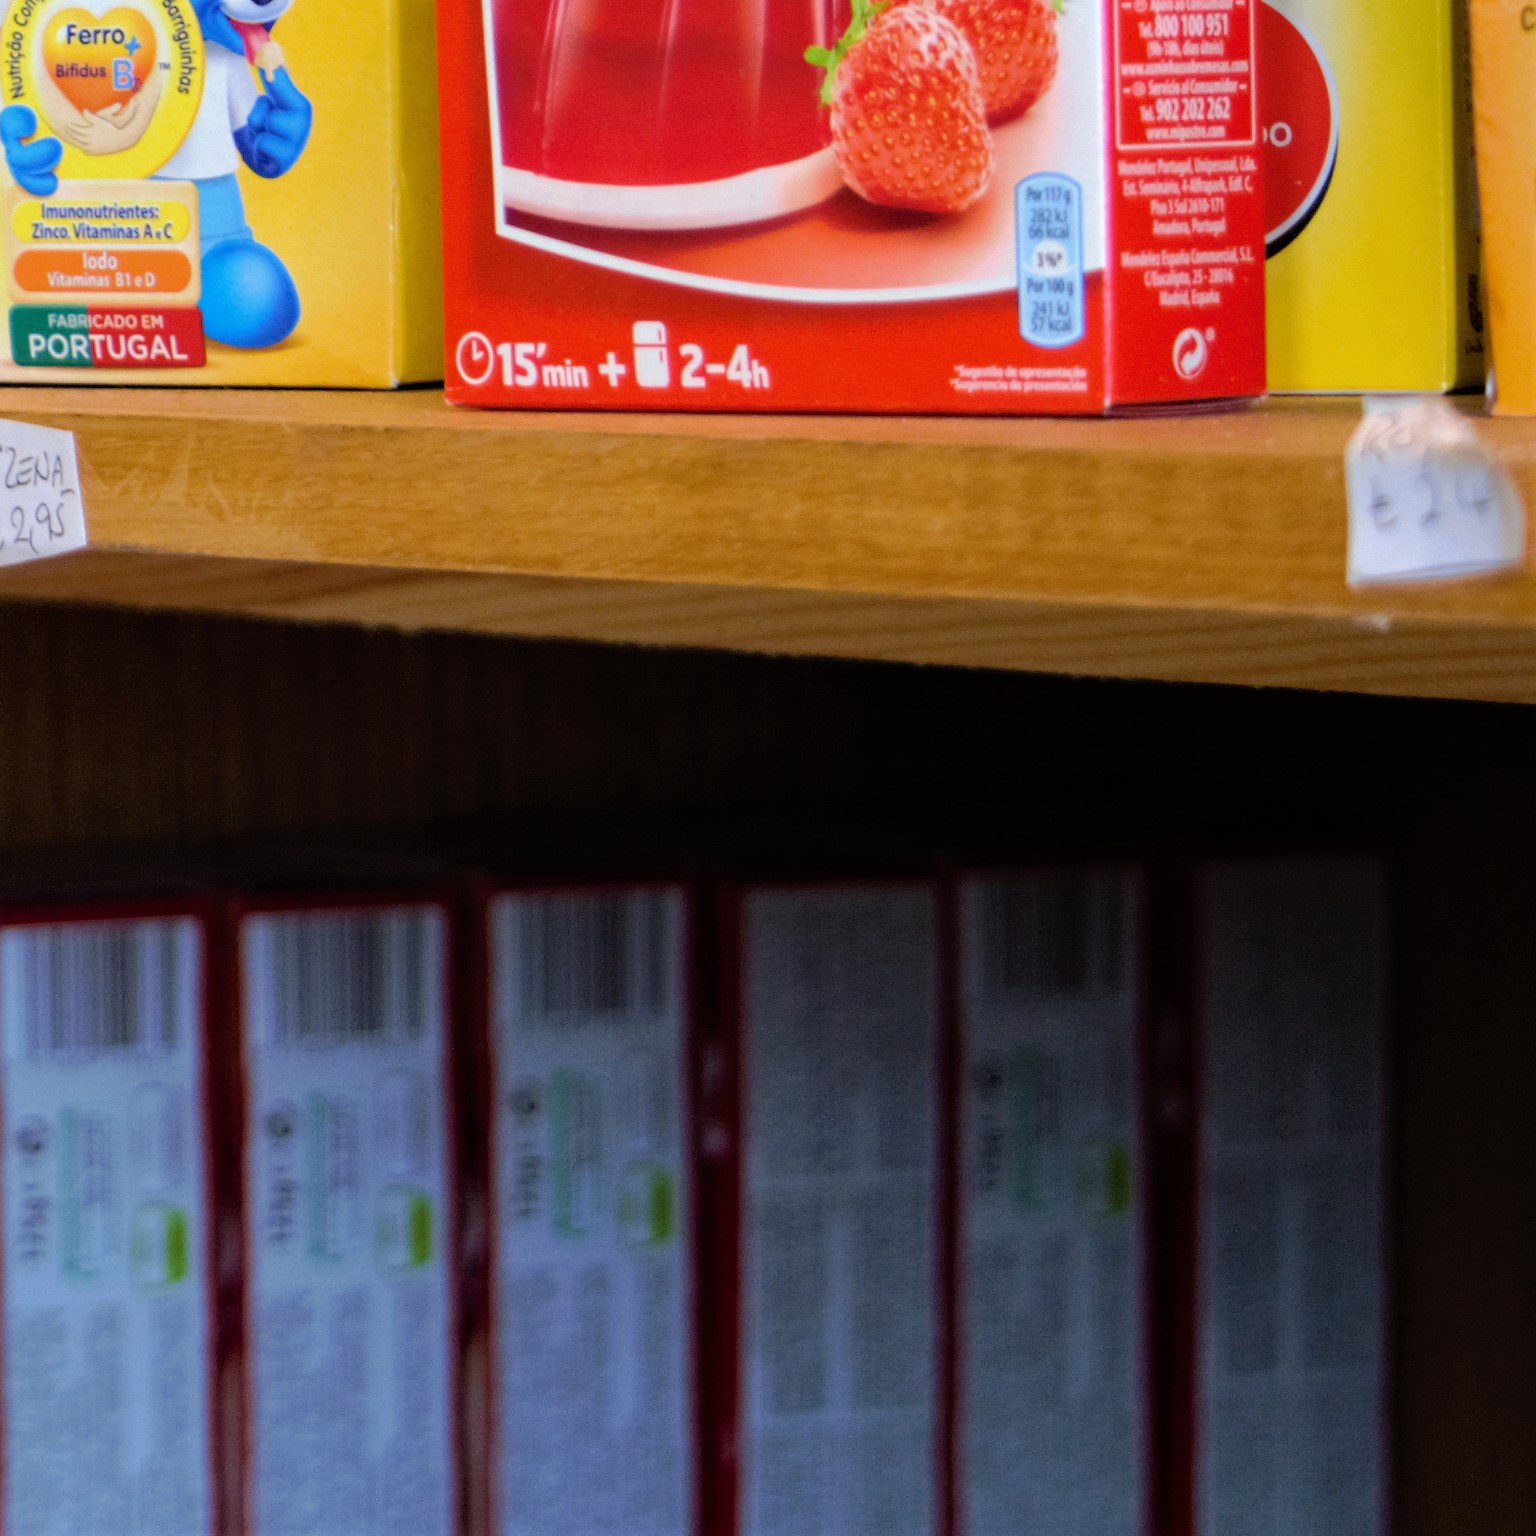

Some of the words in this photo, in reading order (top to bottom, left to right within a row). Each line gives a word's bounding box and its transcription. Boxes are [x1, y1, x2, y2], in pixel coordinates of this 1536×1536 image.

[1154, 14, 1178, 38] 800
[1181, 13, 1204, 37] 100
[1206, 13, 1229, 36] 951
[66, 24, 125, 45] Ferro
[6, 31, 25, 100] Nutrição
[55, 63, 106, 79] Bifidus
[1156, 97, 1179, 121] 902
[1181, 97, 1205, 121] 202
[1207, 96, 1230, 120] 262
[1026, 187, 1043, 202] Por
[1045, 187, 1063, 202] 117
[41, 203, 160, 220] Imunonutrientes:
[1029, 208, 1052, 222] 282
[1056, 208, 1067, 222] kJ
[73, 222, 140, 239] Vitaminas
[143, 224, 153, 239] A
[155, 230, 162, 239] e
[164, 222, 173, 239] C
[1029, 225, 1043, 239] 66
[1046, 224, 1069, 239] kcal
[83, 251, 118, 269] Iodo
[47, 272, 110, 287] Vitaminas
[116, 272, 130, 287] B1
[134, 276, 142, 287] e
[145, 272, 155, 287] D
[1032, 302, 1053, 315] 241
[1058, 301, 1069, 315] kJ
[48, 314, 138, 329] FABRICADO
[141, 314, 164, 329] EM
[1031, 317, 1045, 331] 57
[1048, 316, 1072, 331] kcal
[28, 333, 189, 361] PORTUGAL
[679, 343, 770, 388] 2-4h
